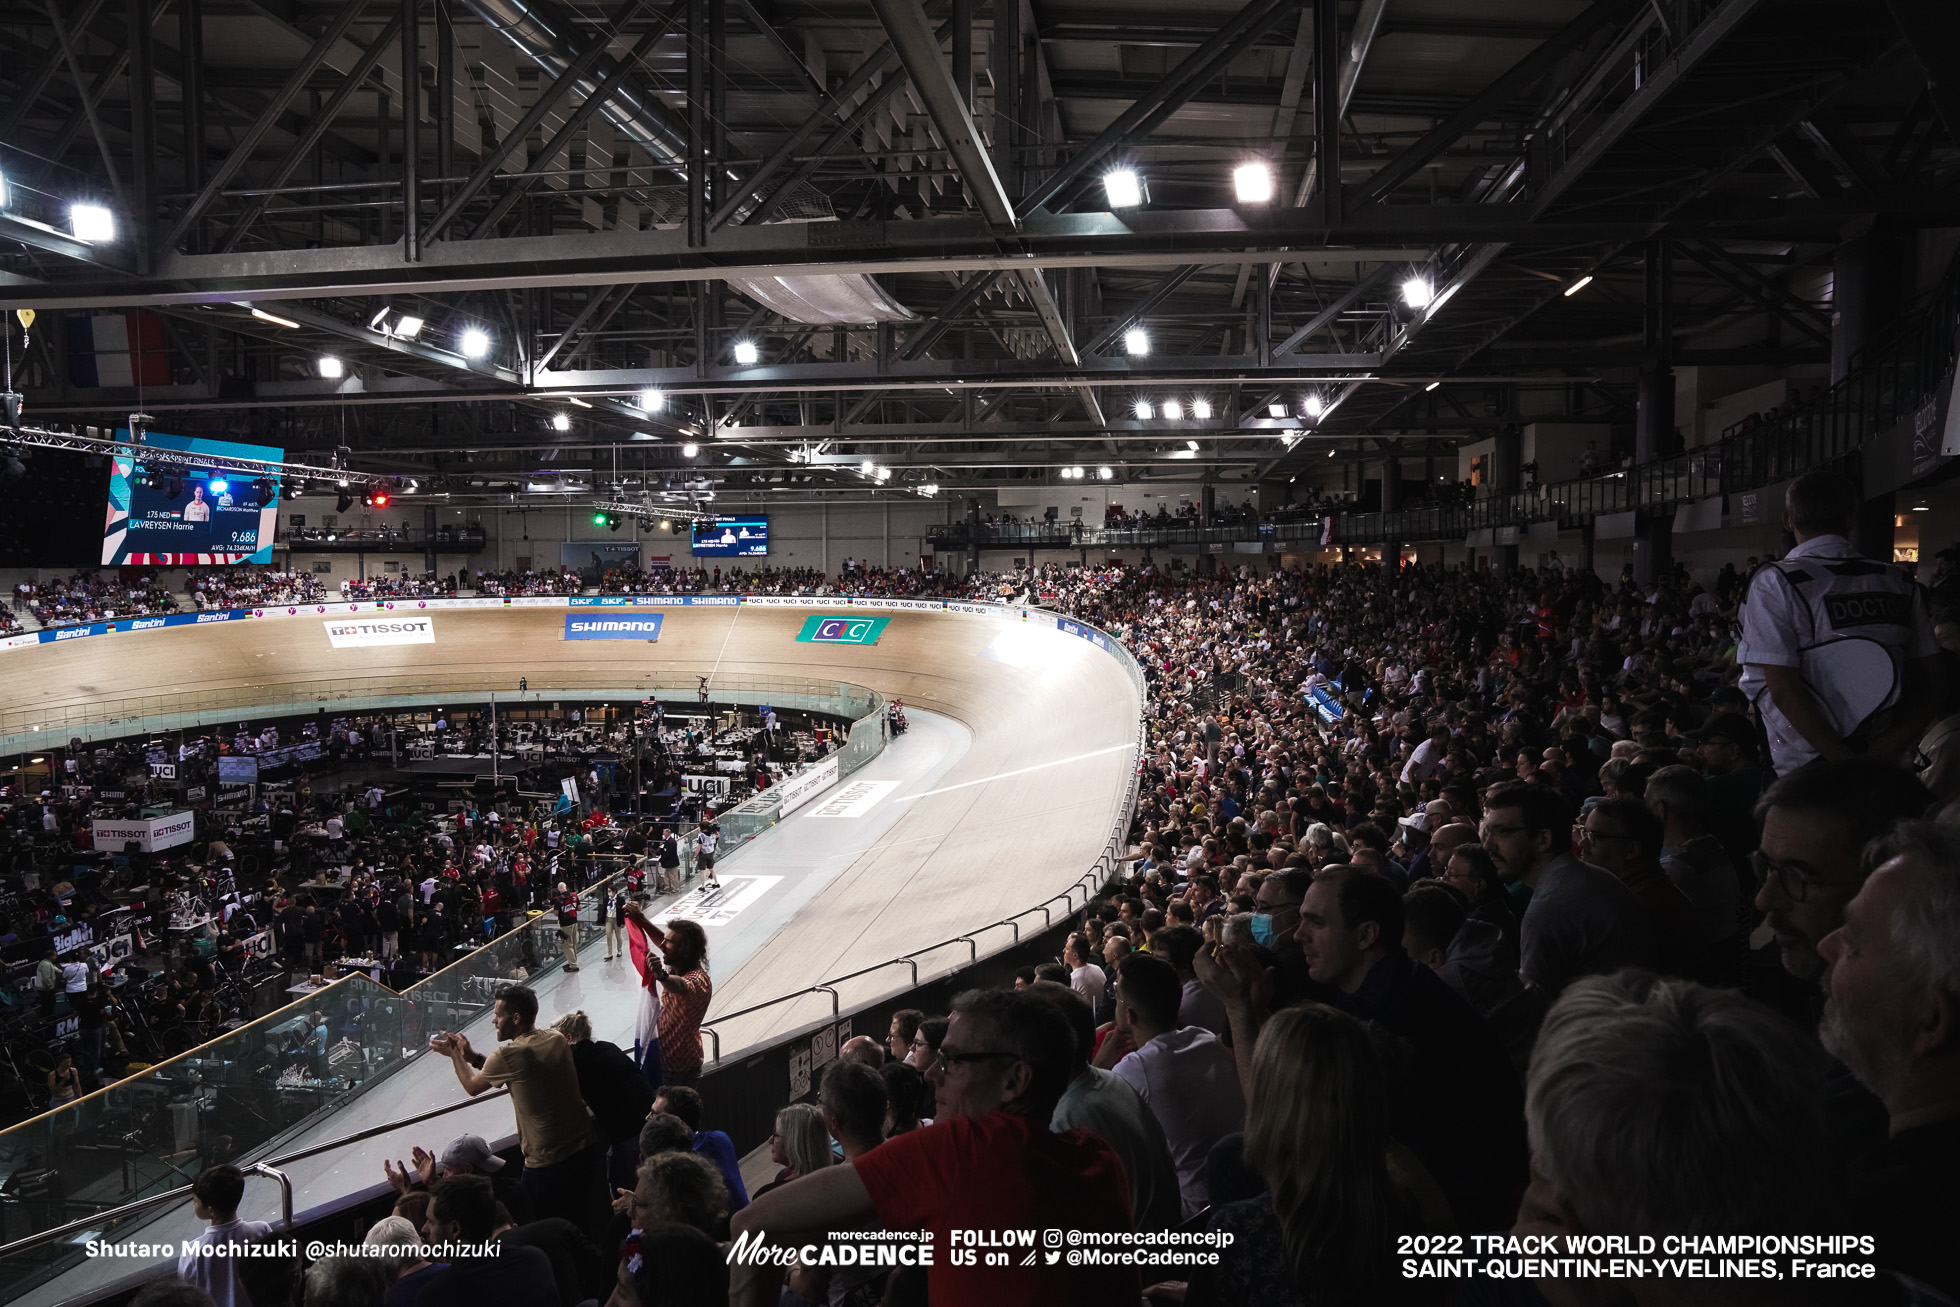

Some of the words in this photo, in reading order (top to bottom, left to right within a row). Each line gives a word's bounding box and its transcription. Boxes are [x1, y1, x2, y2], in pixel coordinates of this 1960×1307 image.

[147, 510, 157, 519] 175
[159, 511, 170, 519] NED
[129, 520, 172, 530] LAVREYSEN
[172, 521, 194, 531] Harrie
[231, 531, 256, 543] 9.686
[197, 612, 230, 623] Santini
[131, 618, 166, 630] Santini
[358, 622, 428, 634] TISSOT
[571, 621, 655, 632] SHIMANO
[822, 622, 865, 637] CIC
[56, 626, 90, 640] Santini
[414, 750, 432, 758] UCI
[154, 766, 174, 776] UCI
[688, 778, 724, 794] UCI
[165, 820, 191, 834] TISSOT
